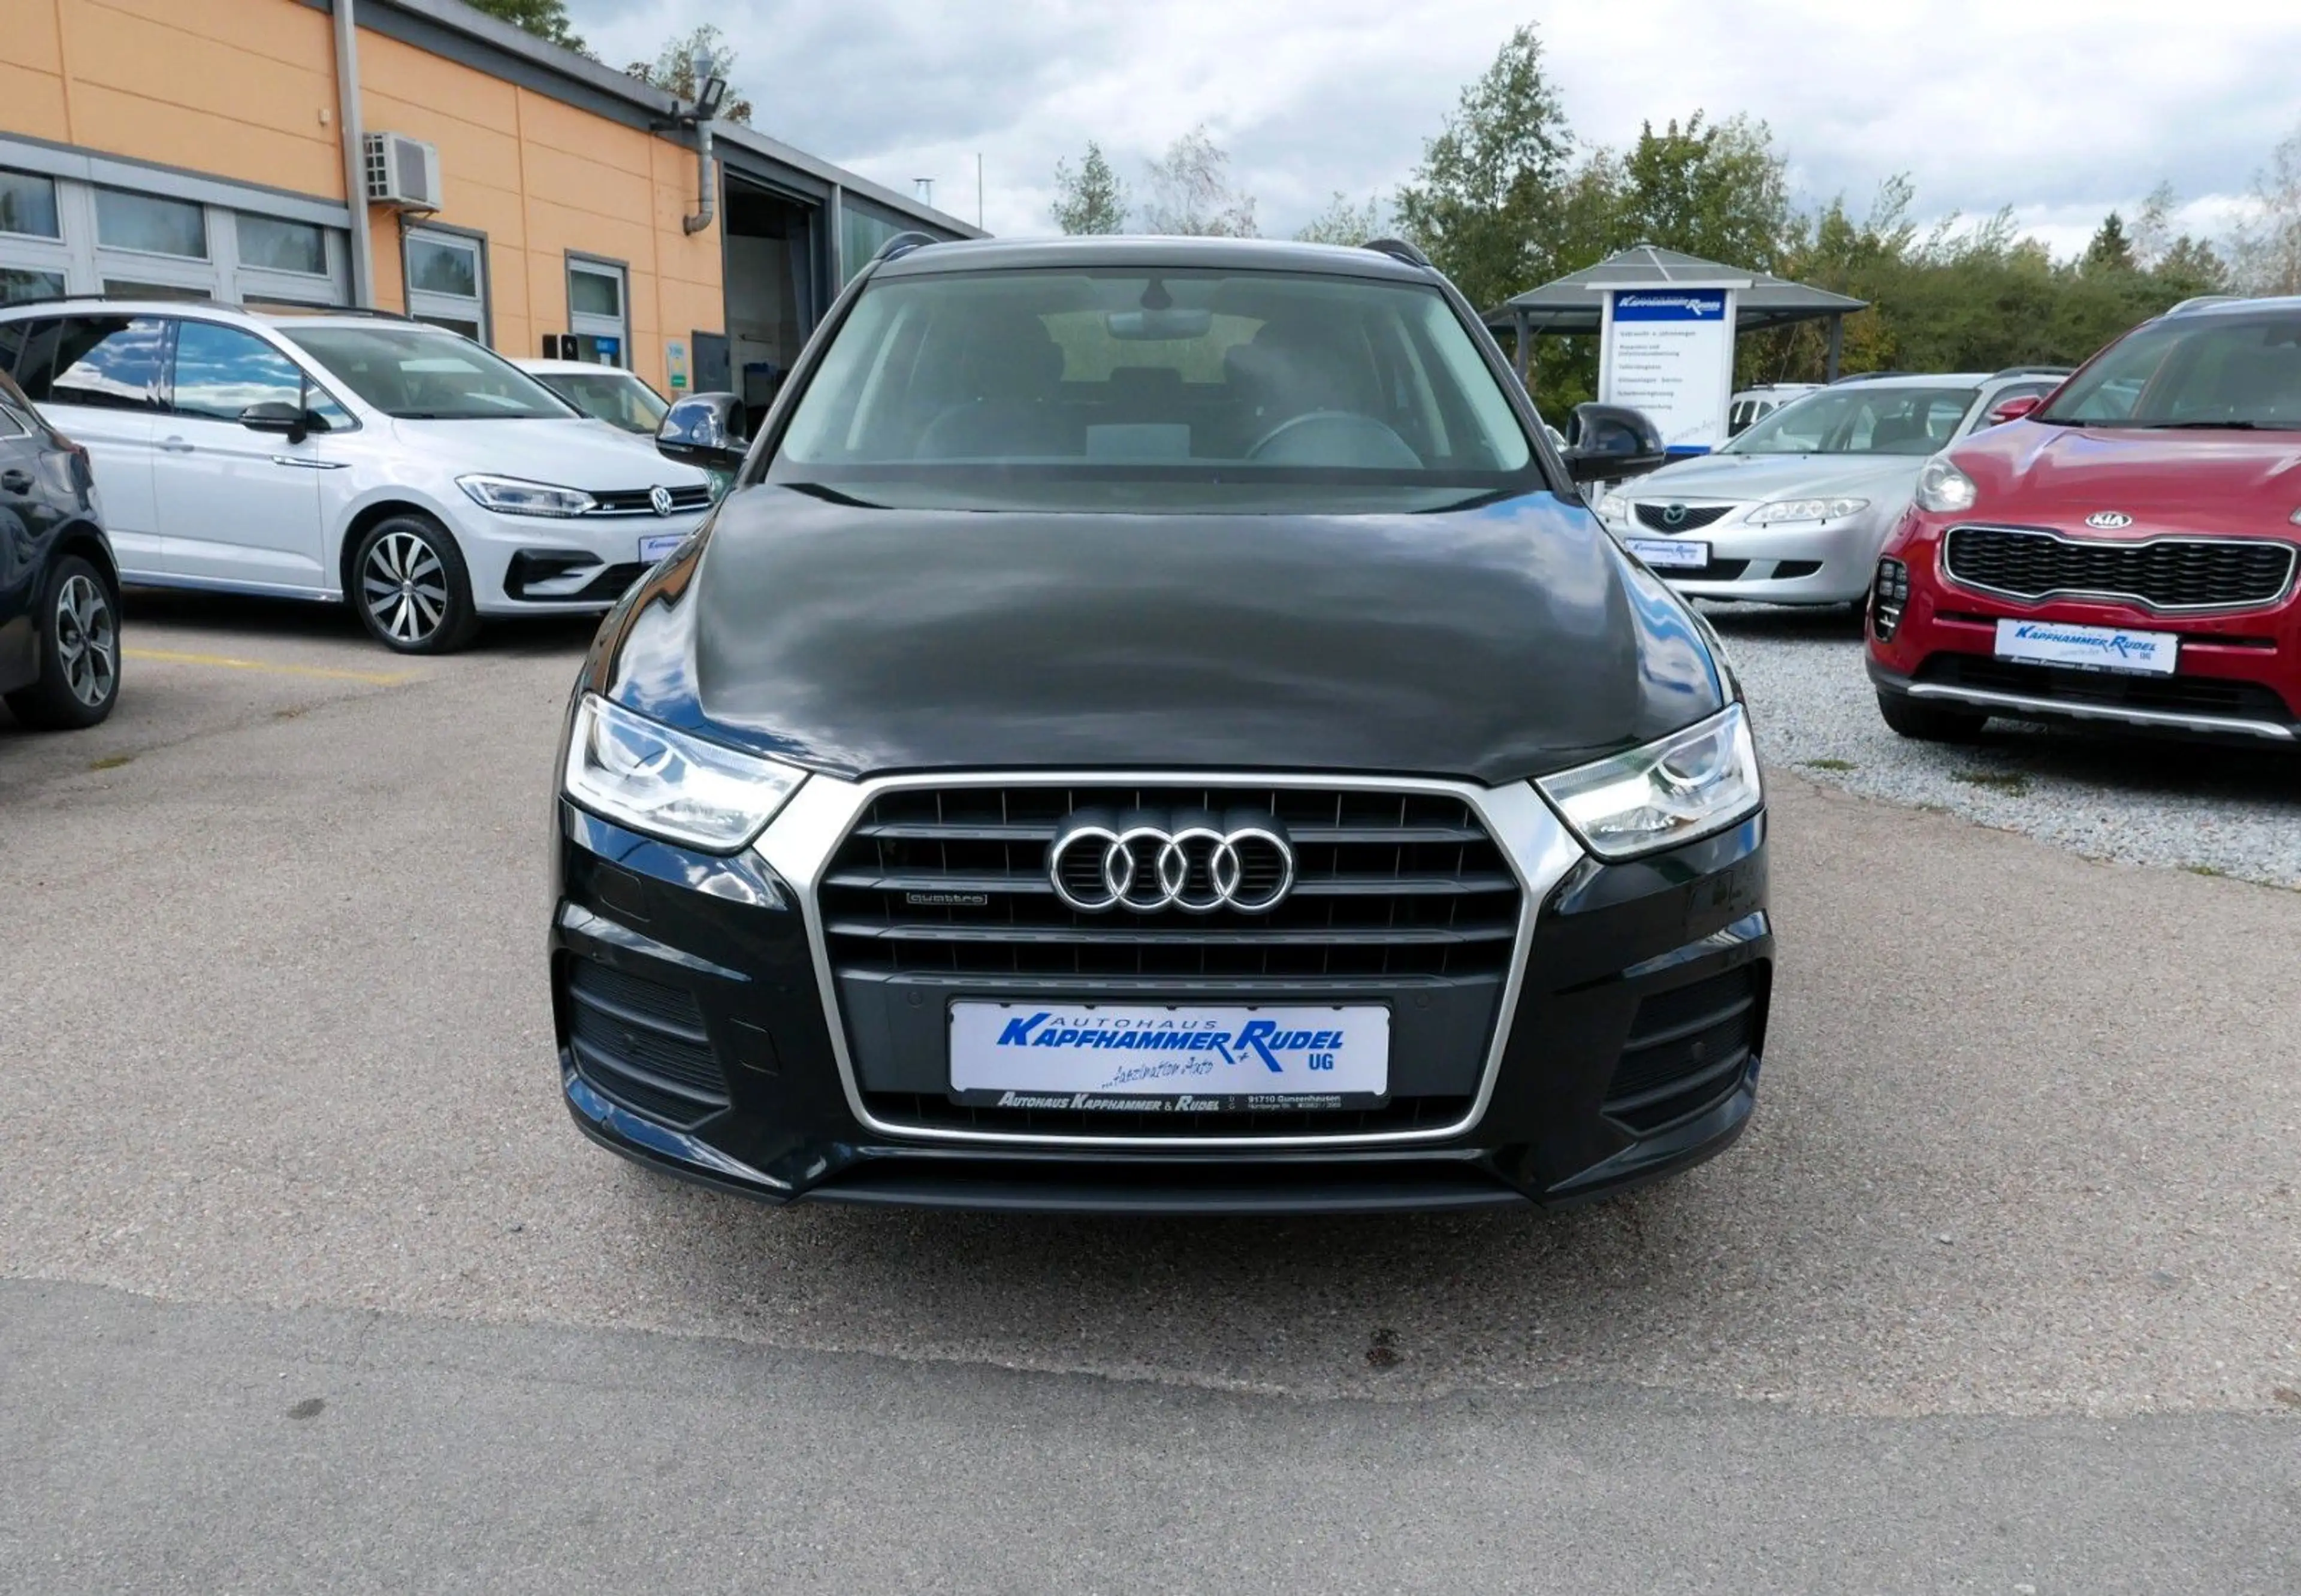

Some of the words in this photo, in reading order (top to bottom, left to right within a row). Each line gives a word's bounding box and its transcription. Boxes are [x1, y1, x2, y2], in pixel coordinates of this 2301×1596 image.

[2092, 514, 2123, 525] KIA
[2109, 635, 2156, 658] RUDEL
[910, 894, 984, 903] quattro
[1050, 1017, 1217, 1029] AUTOHAUS
[997, 1012, 1236, 1064] KAPFHAMMER
[1232, 1020, 1345, 1072] RUDEL
[1308, 1053, 1334, 1070] UG
[998, 1091, 1070, 1108] AUTOHAUS
[1071, 1093, 1161, 1111] KAPFHAMMER
[1174, 1095, 1219, 1111] RUDEL
